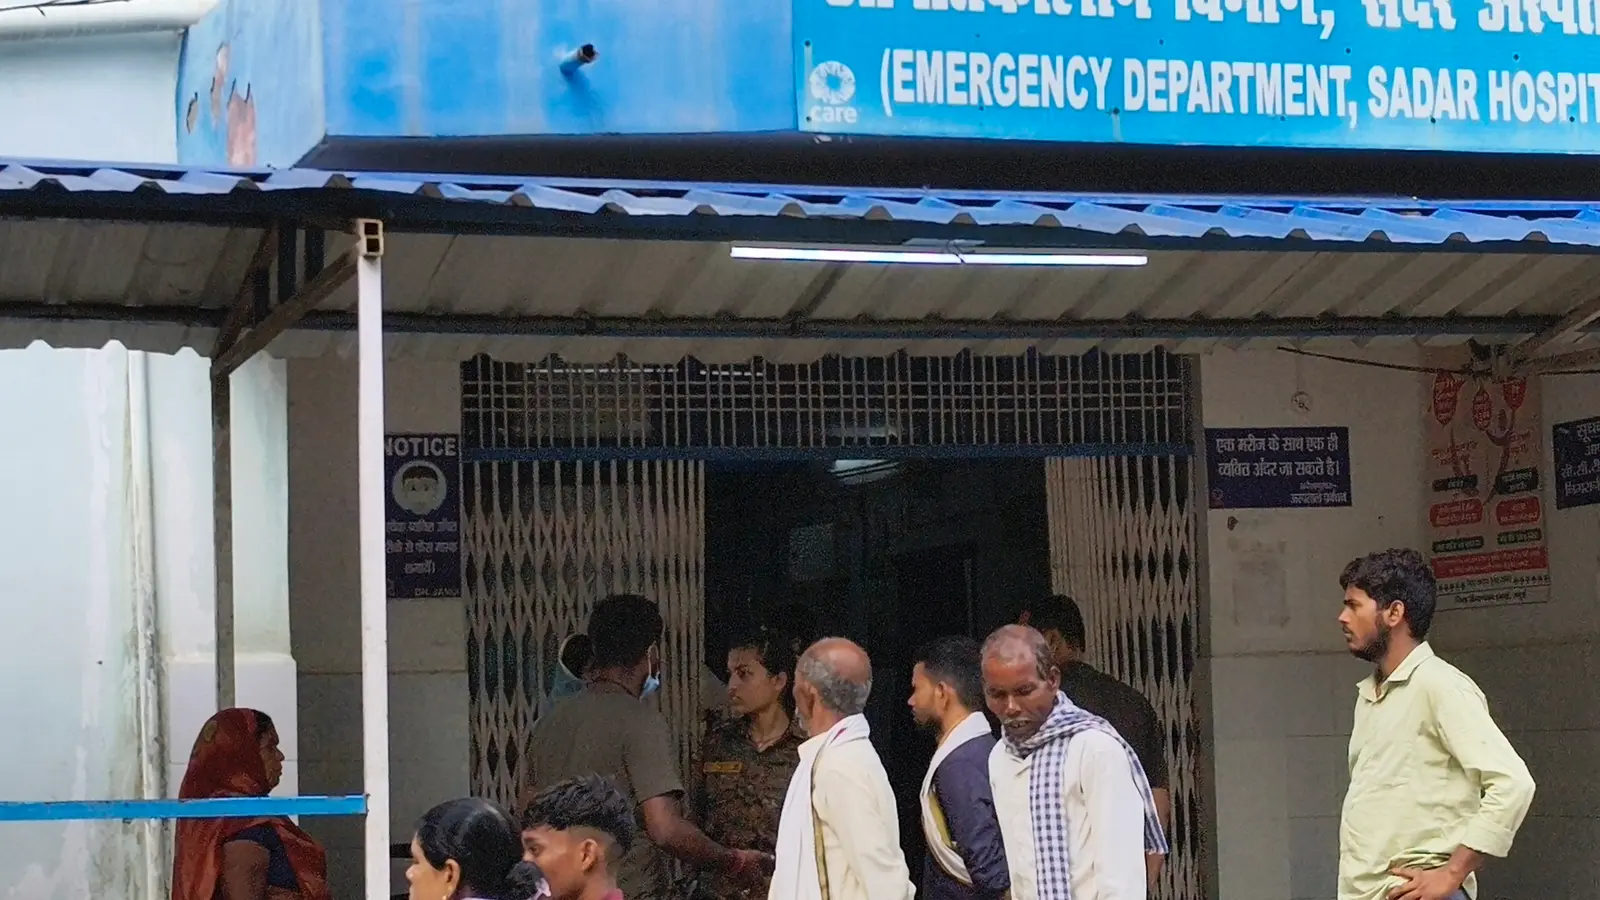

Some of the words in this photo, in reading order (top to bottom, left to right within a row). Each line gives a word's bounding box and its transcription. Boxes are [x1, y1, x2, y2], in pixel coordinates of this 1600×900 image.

[879, 48, 1113, 117] (EMERGENCY
[1124, 57, 1358, 131] DEPARTMENT,
[1367, 65, 1480, 122] SADAR
[809, 105, 859, 124] care
[1216, 438, 1236, 453] एक
[1237, 433, 1266, 452] मरीज
[1267, 433, 1280, 451] के
[1281, 437, 1304, 452] साथ
[1305, 437, 1325, 452] एक
[1326, 432, 1339, 451] ही
[1278, 461, 1293, 476] जा
[1294, 457, 1325, 476] सकते
